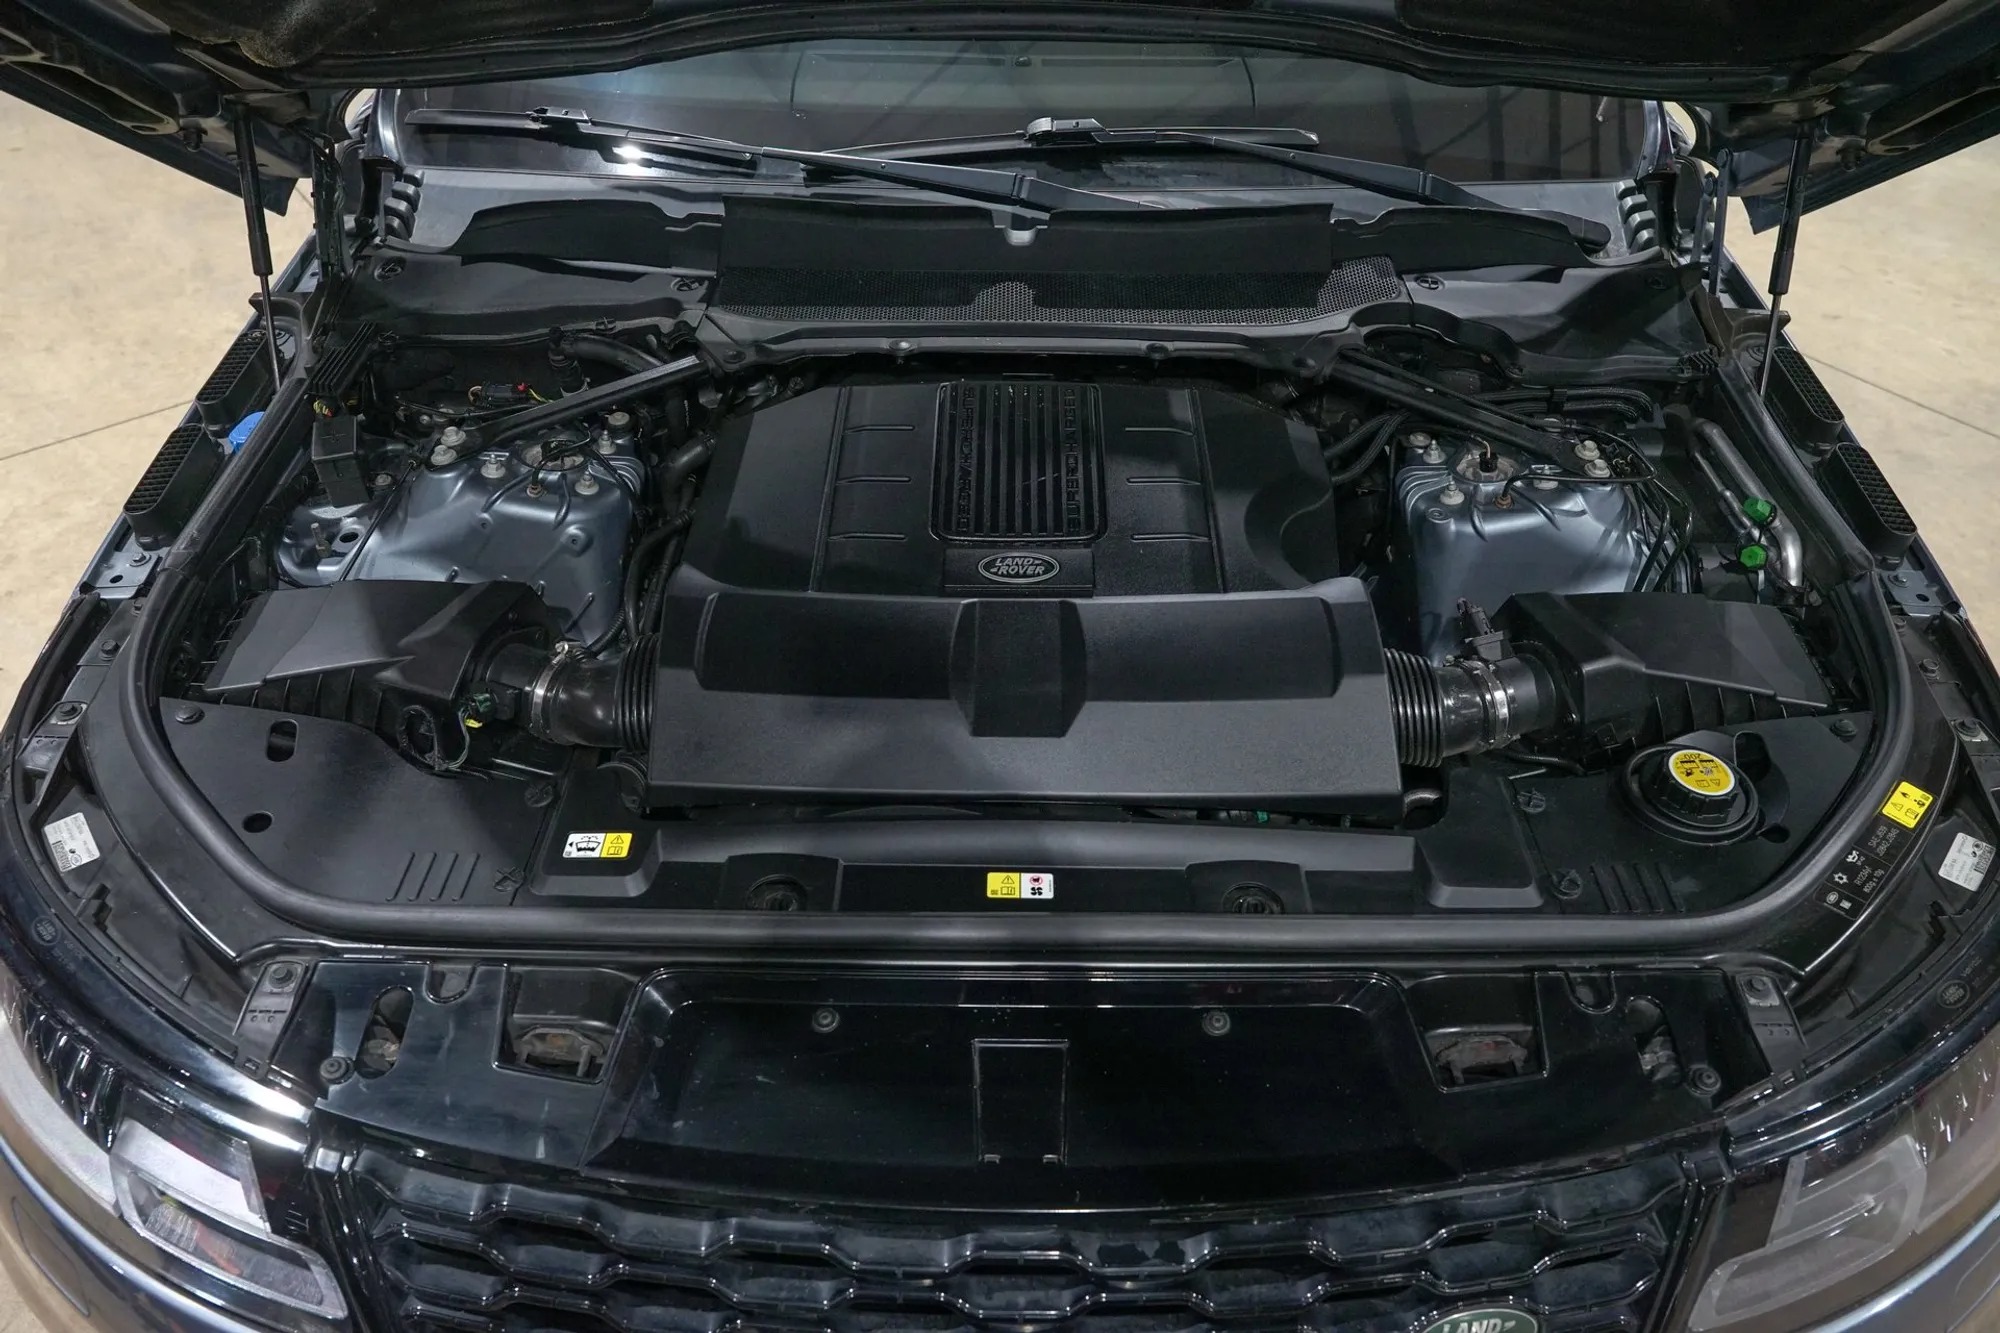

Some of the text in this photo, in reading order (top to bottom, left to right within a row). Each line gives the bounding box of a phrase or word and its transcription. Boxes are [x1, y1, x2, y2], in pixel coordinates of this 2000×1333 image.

[958, 387, 975, 532] SUPERCHARGED
[1064, 388, 1080, 532] SUPERCHARGED
[995, 557, 1034, 566] LAND
[997, 565, 1045, 575] ROVER
